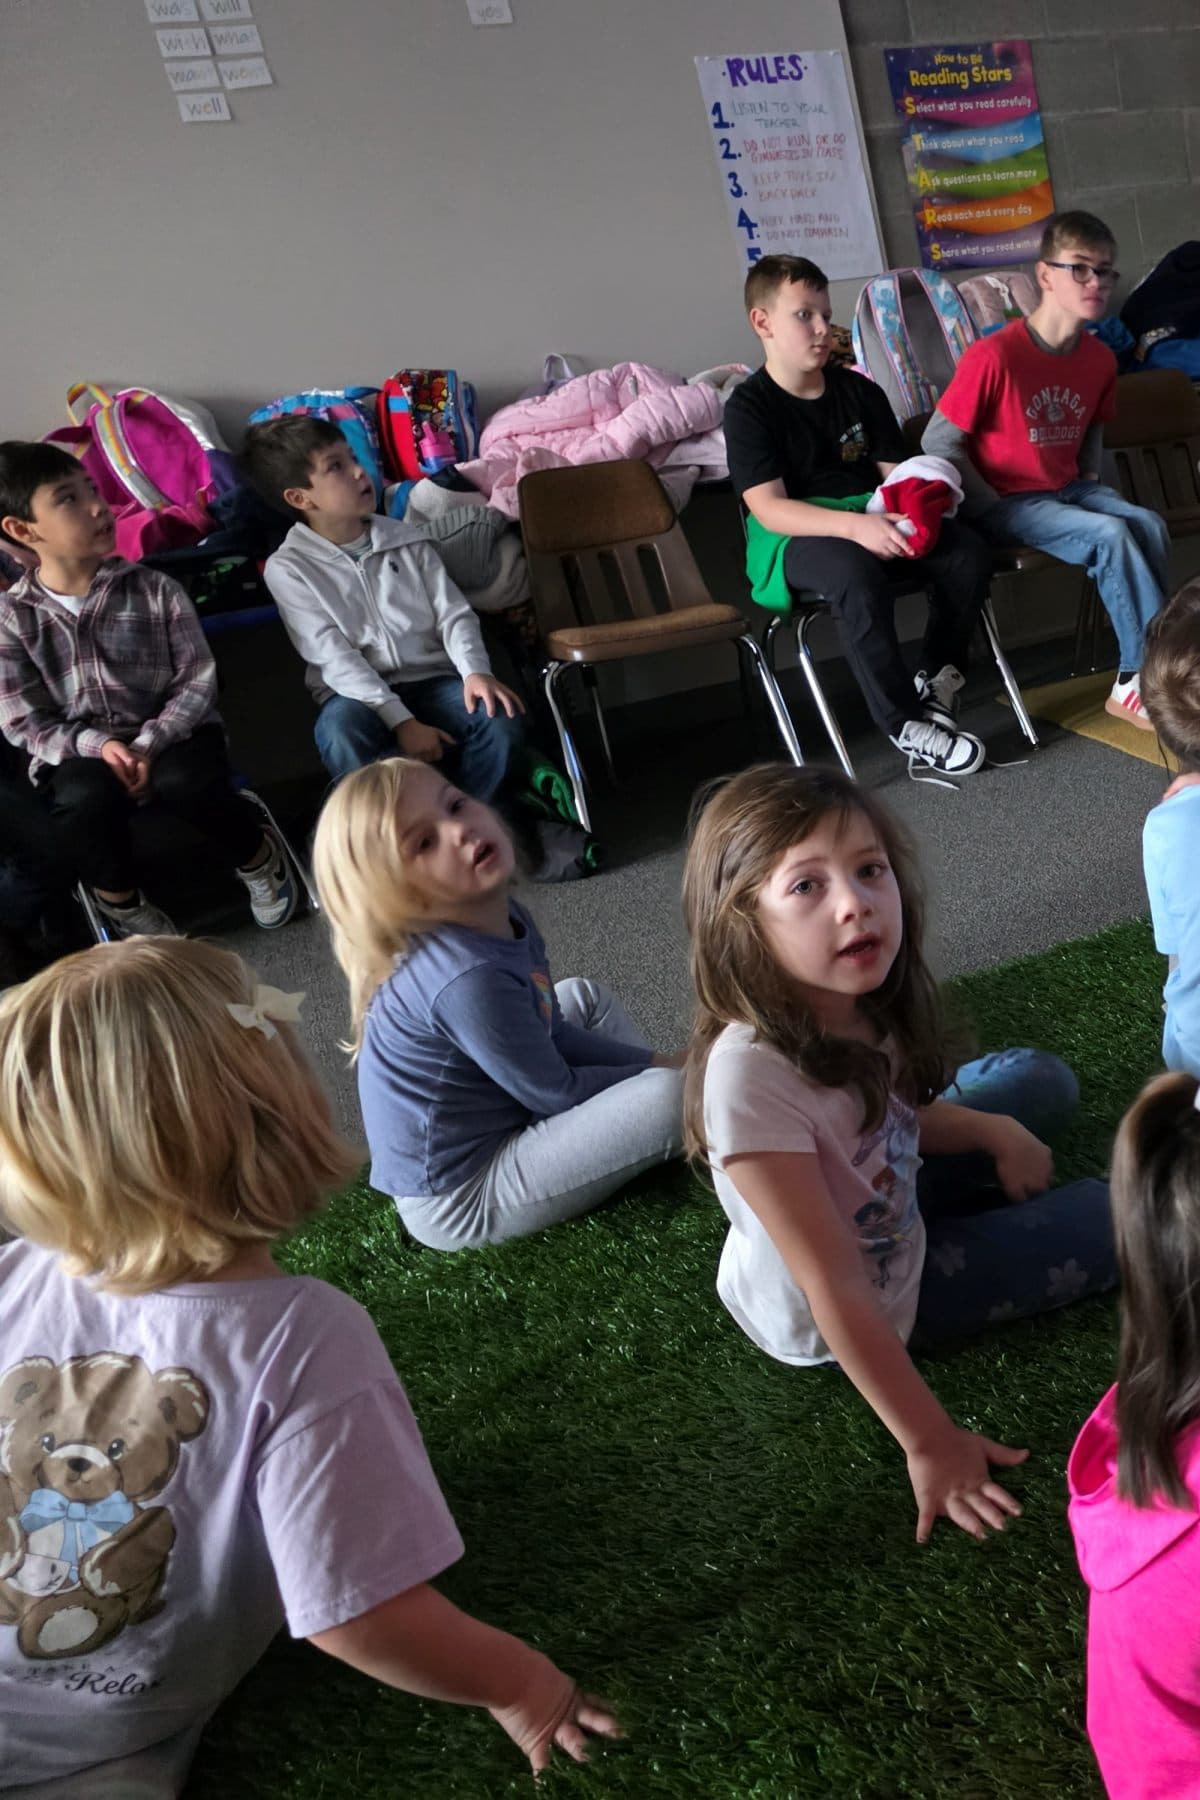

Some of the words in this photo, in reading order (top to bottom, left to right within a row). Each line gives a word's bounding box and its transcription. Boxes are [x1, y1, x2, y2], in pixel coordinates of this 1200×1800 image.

[726, 54, 803, 87] RULES
[934, 54, 955, 66] How
[957, 53, 968, 65] to
[909, 68, 969, 89] Reading
[972, 66, 1012, 83] Stars
[186, 97, 222, 115] well
[711, 101, 735, 129] 1.
[732, 100, 768, 116] LISTEN
[772, 101, 790, 114] TO
[795, 102, 828, 115] YOUR
[905, 97, 935, 114] Select
[938, 99, 957, 111] what
[960, 100, 973, 113] you
[976, 97, 994, 108] read
[996, 95, 1031, 109] carefully
[754, 118, 801, 129] TEACHER
[719, 138, 742, 160] 2.
[834, 133, 846, 145] DO
[912, 133, 938, 151] Think
[942, 138, 964, 149] about
[967, 136, 986, 147] what
[988, 136, 1003, 148] you
[1005, 133, 1024, 144] read
[728, 171, 748, 199] 3.
[918, 168, 940, 188] Ask
[943, 172, 980, 187] questions
[983, 171, 992, 181] to
[994, 170, 1015, 180] learn
[1017, 169, 1037, 178] more
[737, 207, 760, 240] 4.
[924, 208, 952, 225] Read
[954, 210, 974, 221] each
[975, 207, 991, 218] and
[993, 206, 1015, 218] every
[1017, 203, 1033, 216] day
[930, 242, 960, 261] Share
[961, 245, 979, 256] what
[981, 245, 995, 257] you
[997, 240, 1014, 252] read
[1025, 384, 1087, 420] GONZAGA
